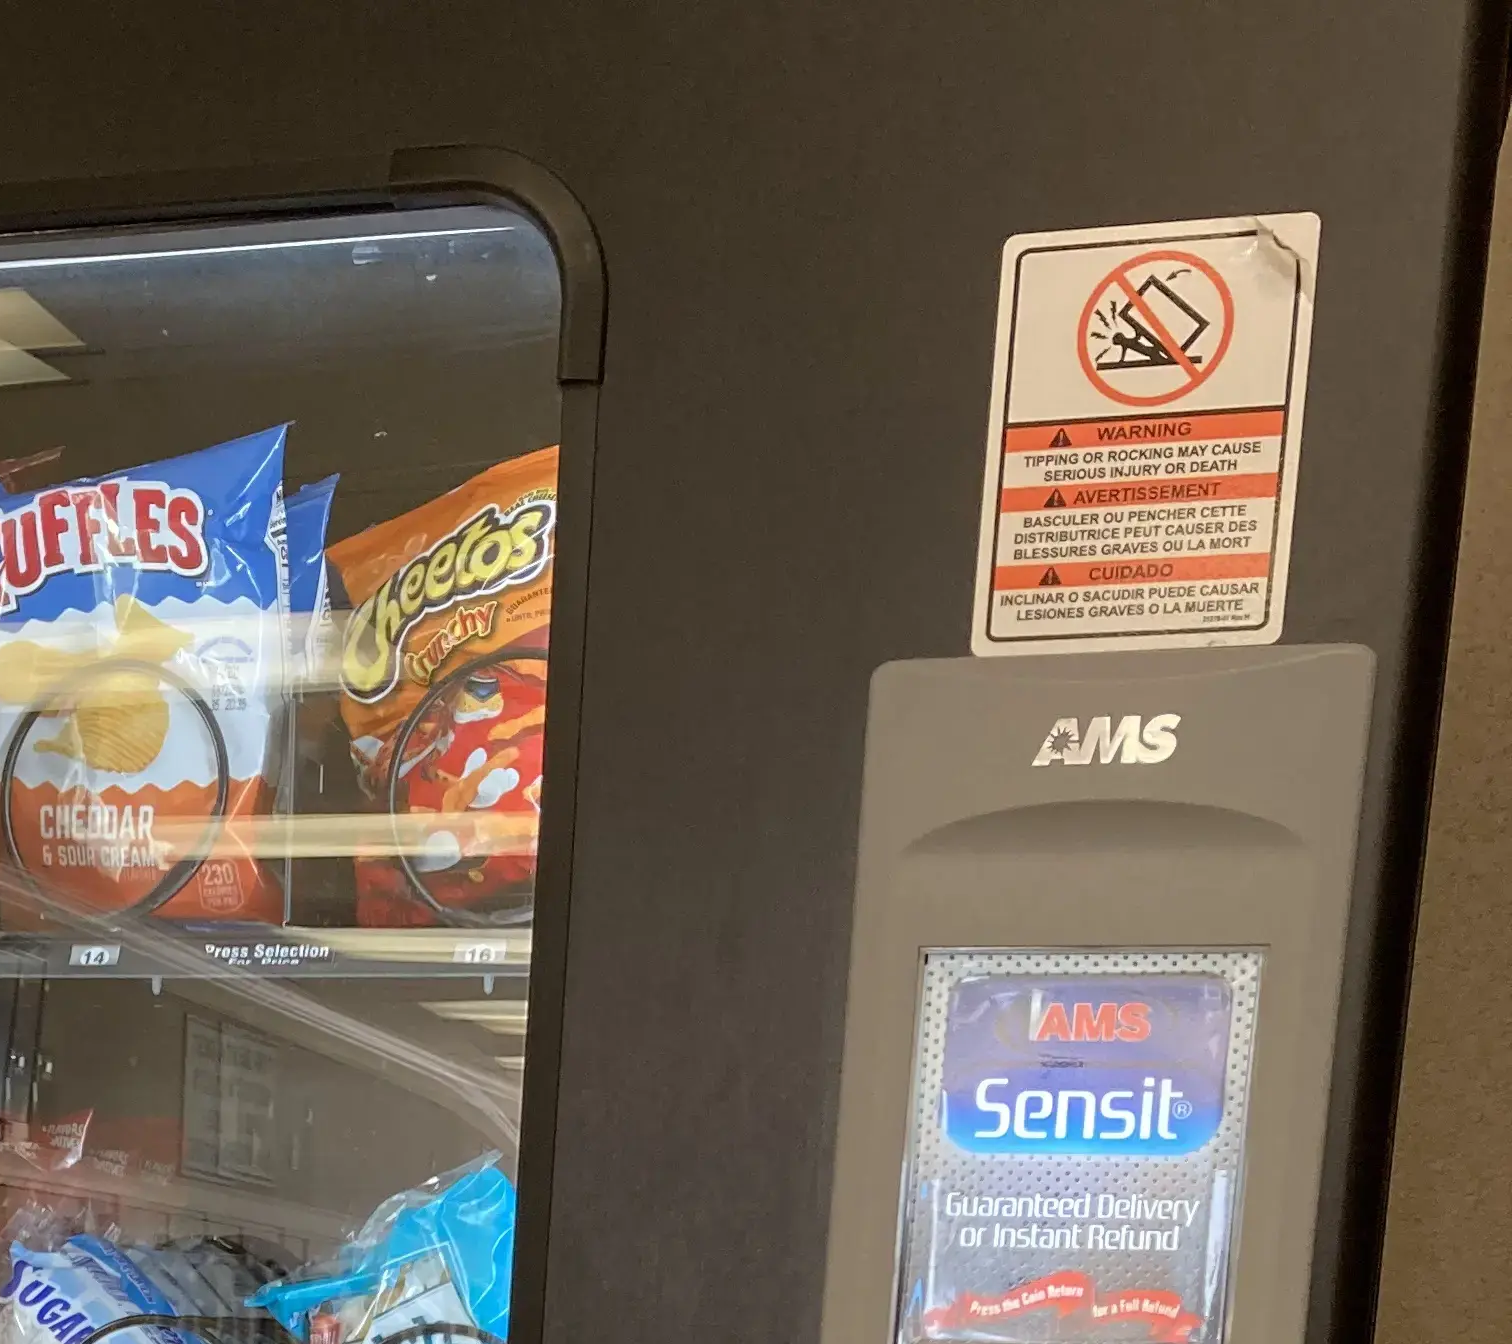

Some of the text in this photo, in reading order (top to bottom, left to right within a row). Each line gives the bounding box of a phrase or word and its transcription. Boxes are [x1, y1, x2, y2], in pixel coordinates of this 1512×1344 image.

[1097, 422, 1192, 441] WARNING
[1024, 441, 1261, 468] TIPPING OR ROCKING MAY CAUSE
[1044, 459, 1237, 482] SERIOUS INJURY OR DEATH
[1073, 482, 1221, 505] AVERTISSEMENT
[1023, 505, 1247, 529] BASCULER OU PENCHER CETTE
[1014, 520, 1257, 544] DISTRIBUTRICE PEUT CAUSER DES
[1013, 536, 1252, 560] BLESSURES GRAVES OU LA MORT
[1088, 564, 1173, 581] CUIDADO
[343, 510, 542, 692] Cheetos
[1000, 582, 1259, 607] INCLINAR O SACUDIR PUEDE CAUSAR
[1017, 599, 1243, 621] LESIONES GRAVES O LA MUERTE
[404, 601, 497, 685] Crunchy
[1031, 713, 1181, 767] AMS
[40, 805, 153, 840] CHEDDAR
[58, 846, 157, 868] SOUR CREAM
[202, 864, 233, 886] 230
[85, 950, 105, 964] 14
[254, 944, 329, 958] Selection
[1036, 1002, 1152, 1041] AMS
[975, 1077, 1184, 1140] Sensit
[946, 1192, 1200, 1227] Guaranteed Delivery
[960, 1224, 1179, 1251] or Instant Refund
[1141, 1299, 1180, 1319] Refund
